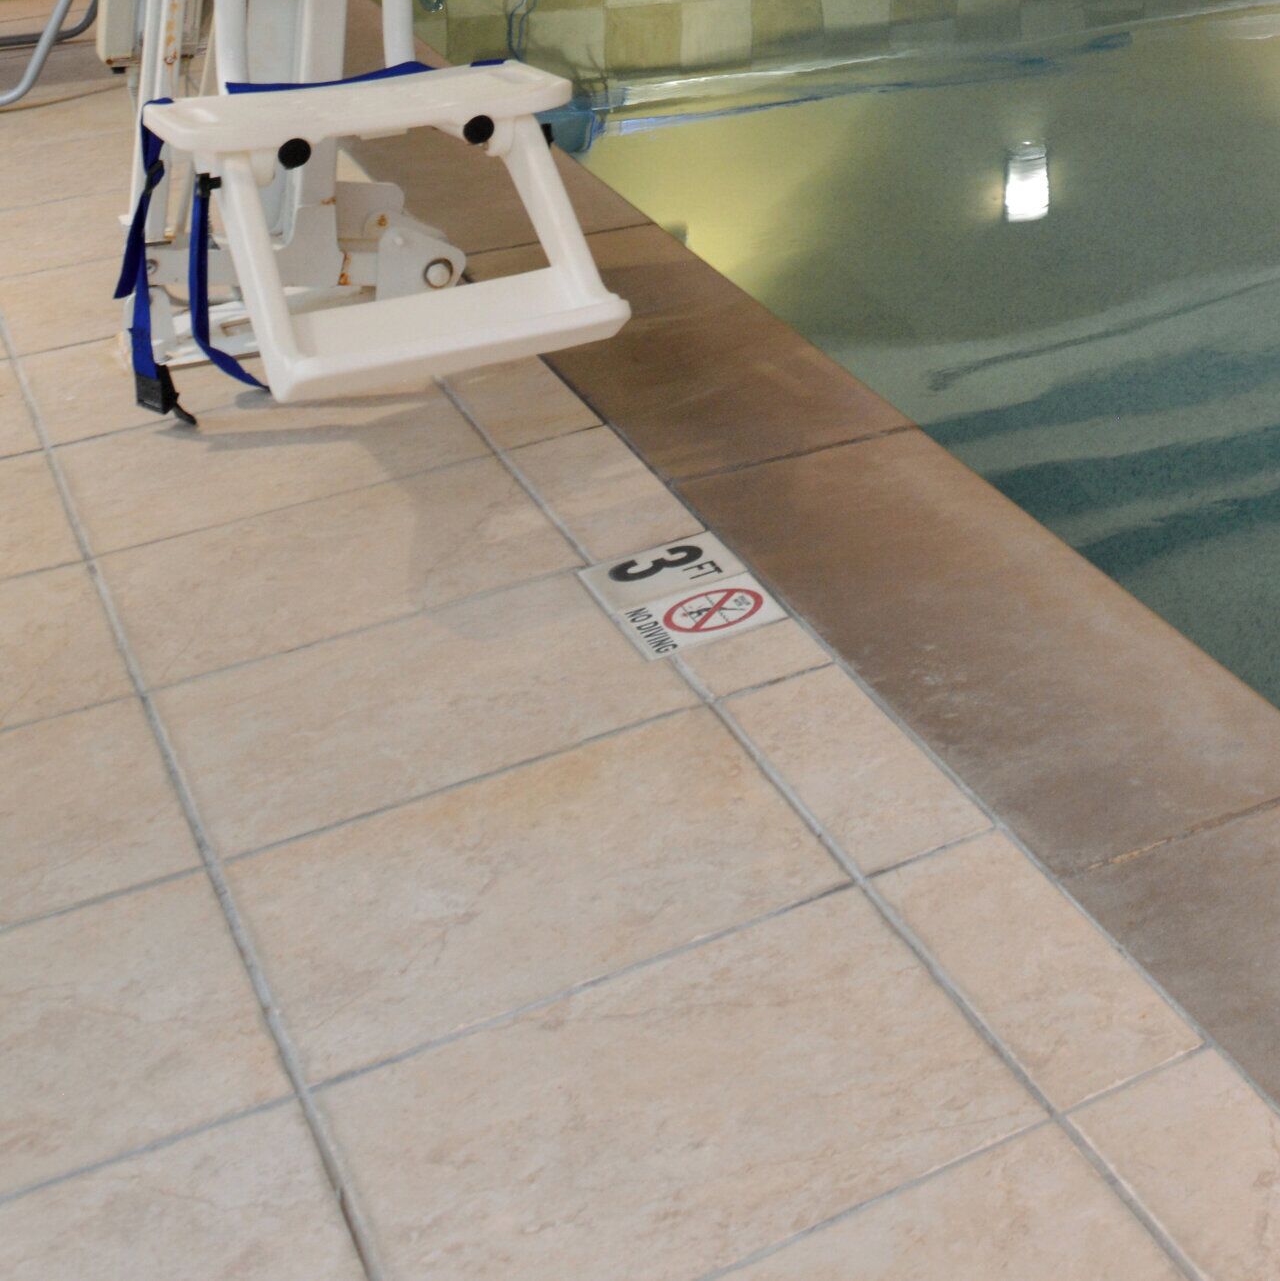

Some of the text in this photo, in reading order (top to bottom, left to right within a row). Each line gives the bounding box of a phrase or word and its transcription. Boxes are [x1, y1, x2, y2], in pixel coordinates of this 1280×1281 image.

[608, 545, 724, 583] 3 FT
[624, 607, 679, 655] NO DIVING
